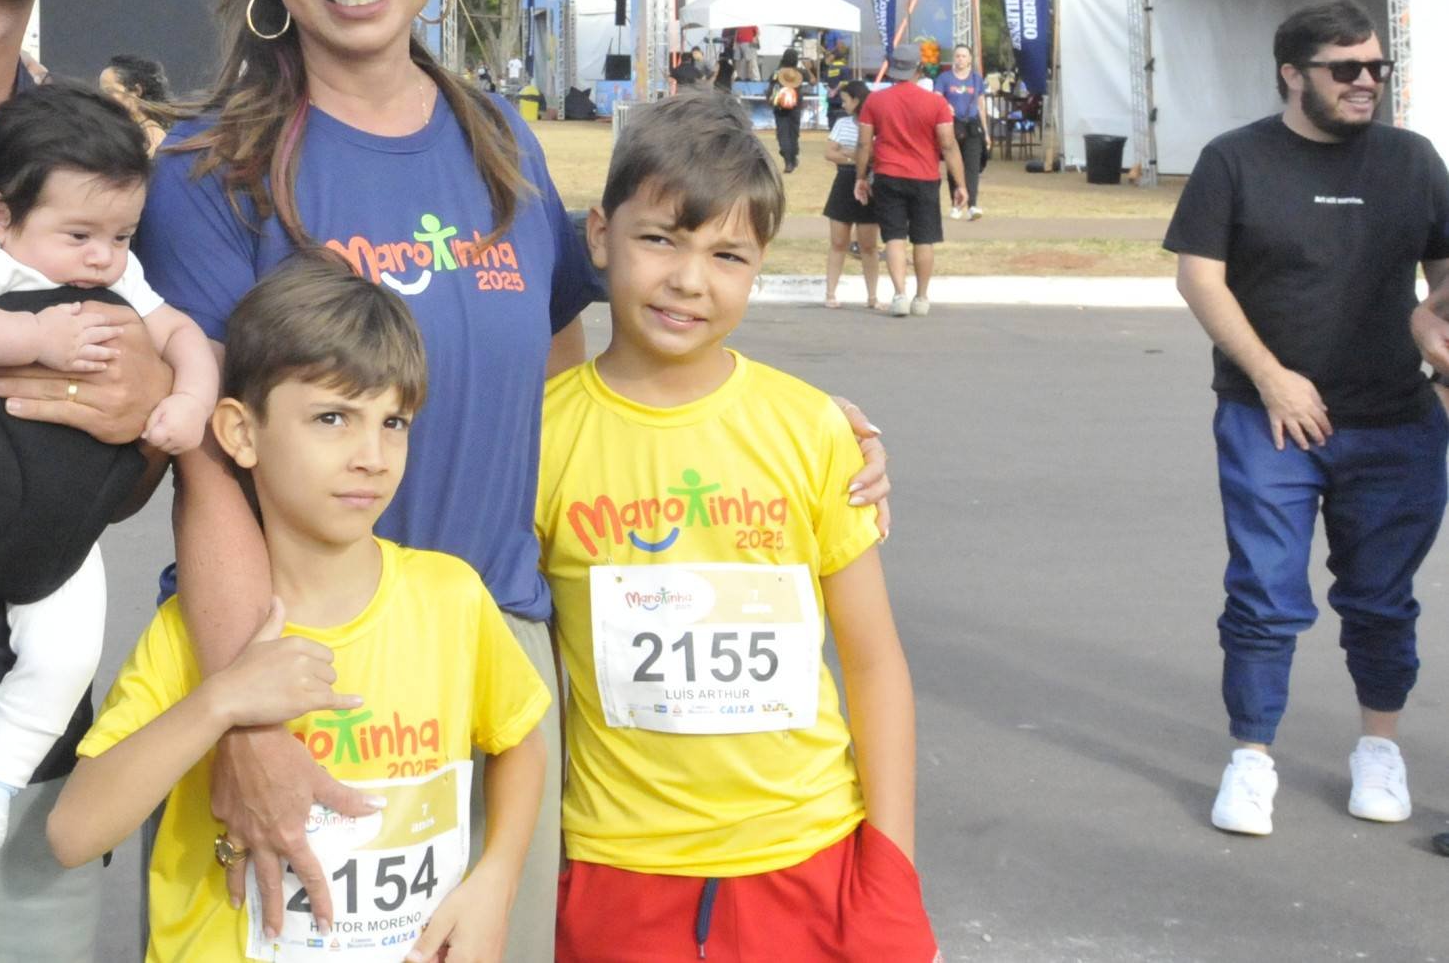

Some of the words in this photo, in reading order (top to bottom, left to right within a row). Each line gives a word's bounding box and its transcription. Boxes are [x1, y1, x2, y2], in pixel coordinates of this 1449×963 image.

[476, 270, 525, 291] 2025
[566, 468, 788, 557] Marotinha
[736, 529, 785, 550] 2025
[625, 587, 692, 608] Marotinha
[632, 631, 779, 682] 2155
[698, 688, 750, 700] ARTHUR
[719, 704, 755, 715] CAIXA
[293, 710, 440, 764] otinha
[310, 921, 363, 933] HITOR
[367, 911, 422, 932] MORENO
[381, 929, 416, 947] CAIXA
